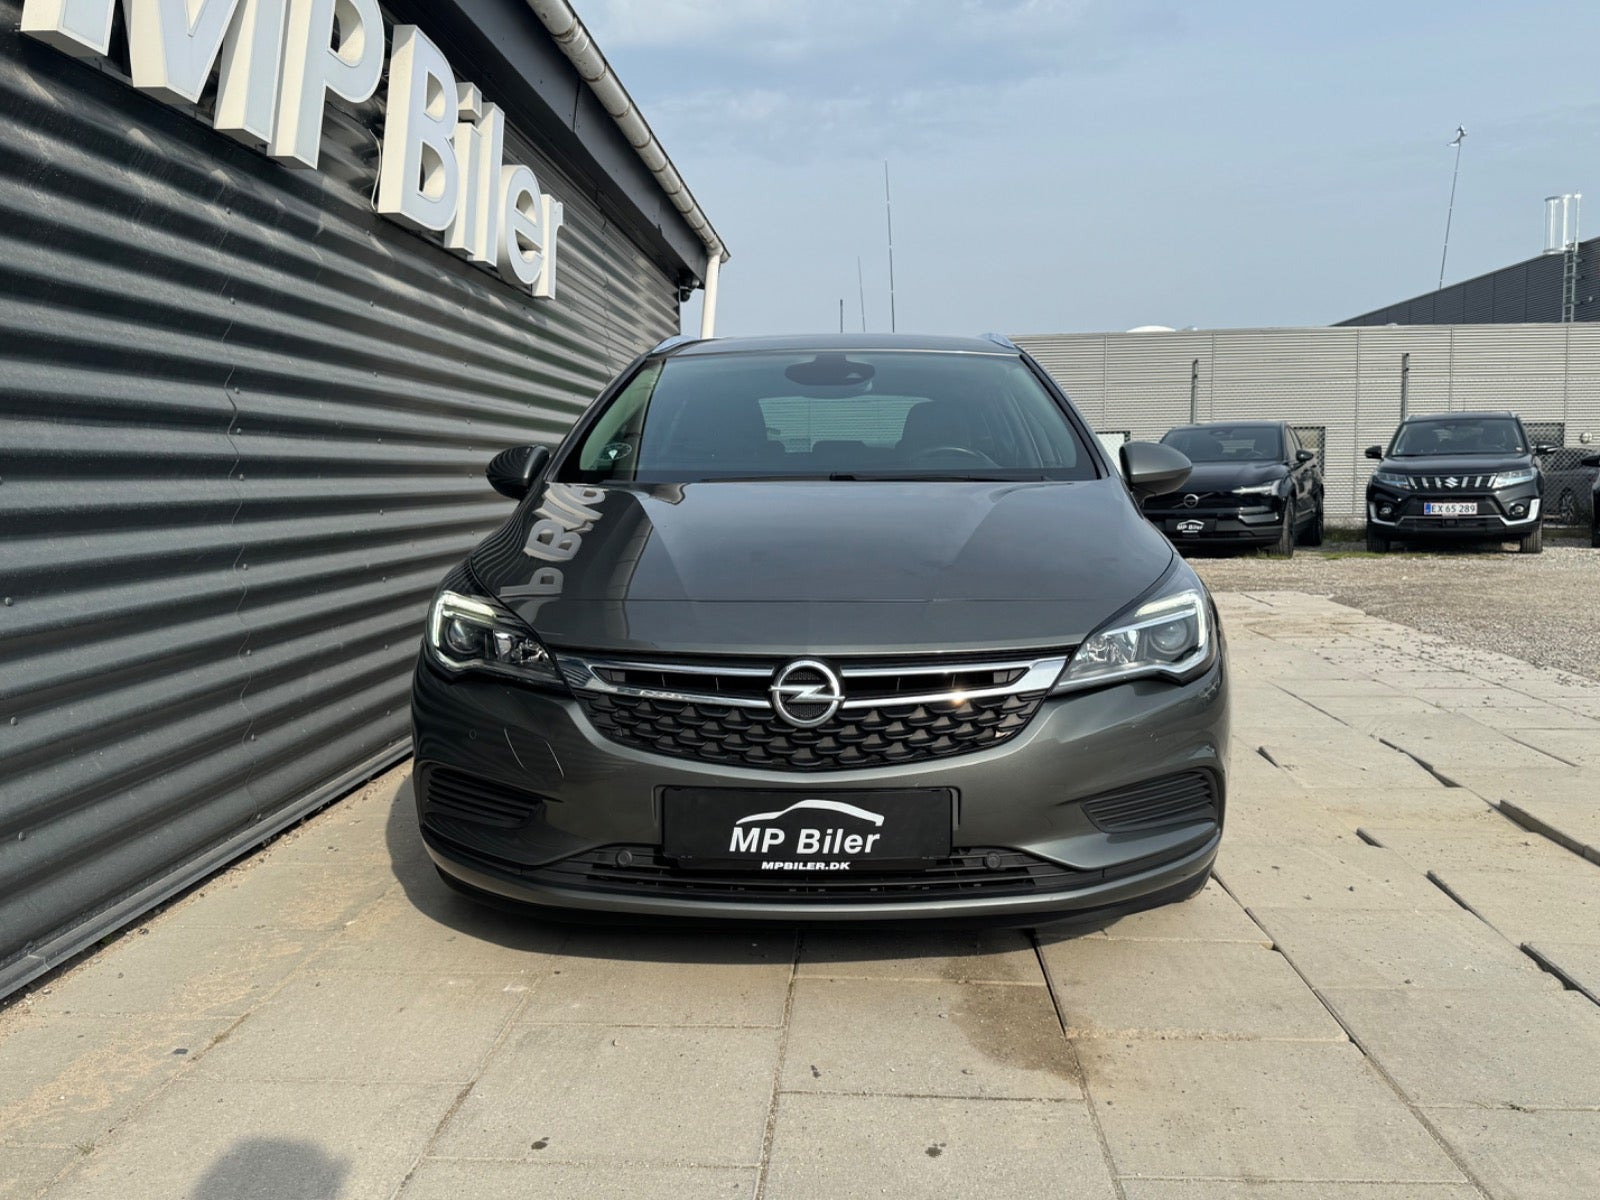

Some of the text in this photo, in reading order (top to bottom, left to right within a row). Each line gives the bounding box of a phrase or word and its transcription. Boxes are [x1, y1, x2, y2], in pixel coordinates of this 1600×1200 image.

[378, 24, 563, 299] Biler
[1432, 504, 1475, 513] EX 65 289
[729, 827, 881, 854] MP Biler
[761, 861, 850, 870] MPBILER.DK
